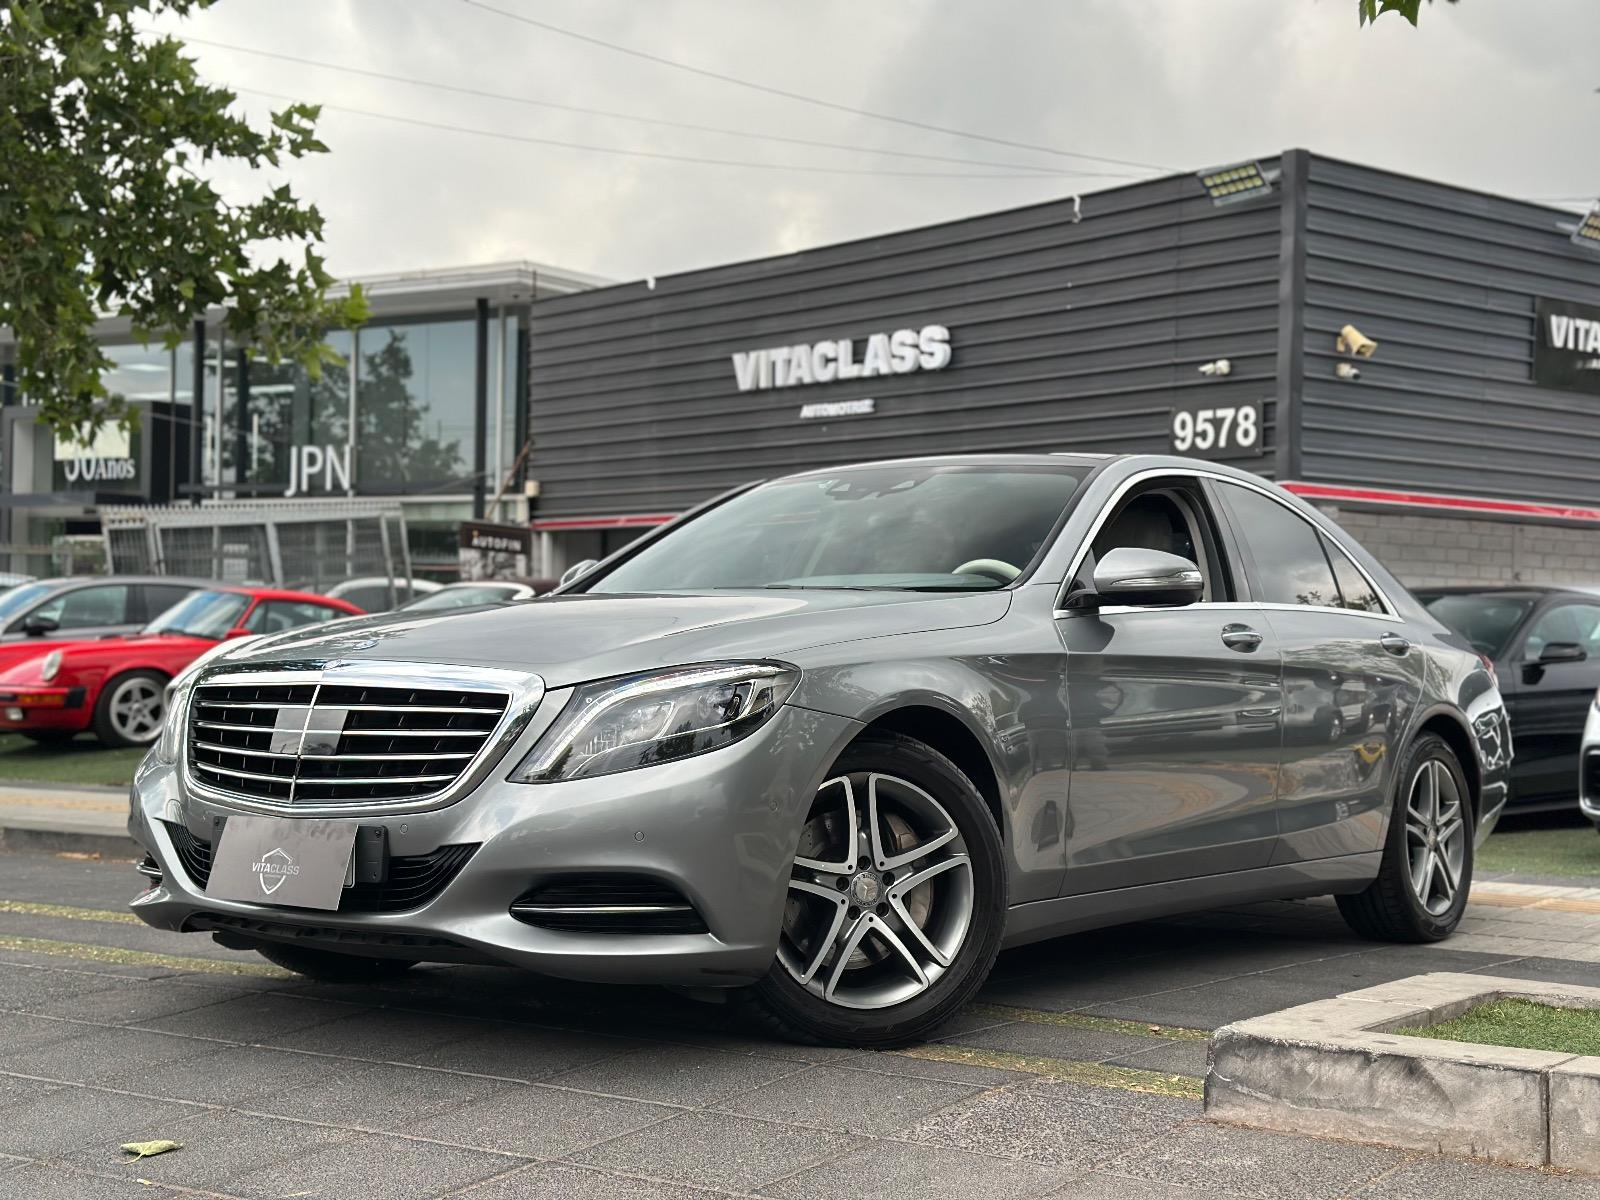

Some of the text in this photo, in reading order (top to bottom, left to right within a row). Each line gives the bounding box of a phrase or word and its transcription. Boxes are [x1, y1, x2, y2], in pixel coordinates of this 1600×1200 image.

[731, 324, 952, 391] VITACLASS
[1173, 405, 1257, 452] 9578
[283, 444, 352, 497] JPN
[252, 861, 300, 876] VITACLASS
